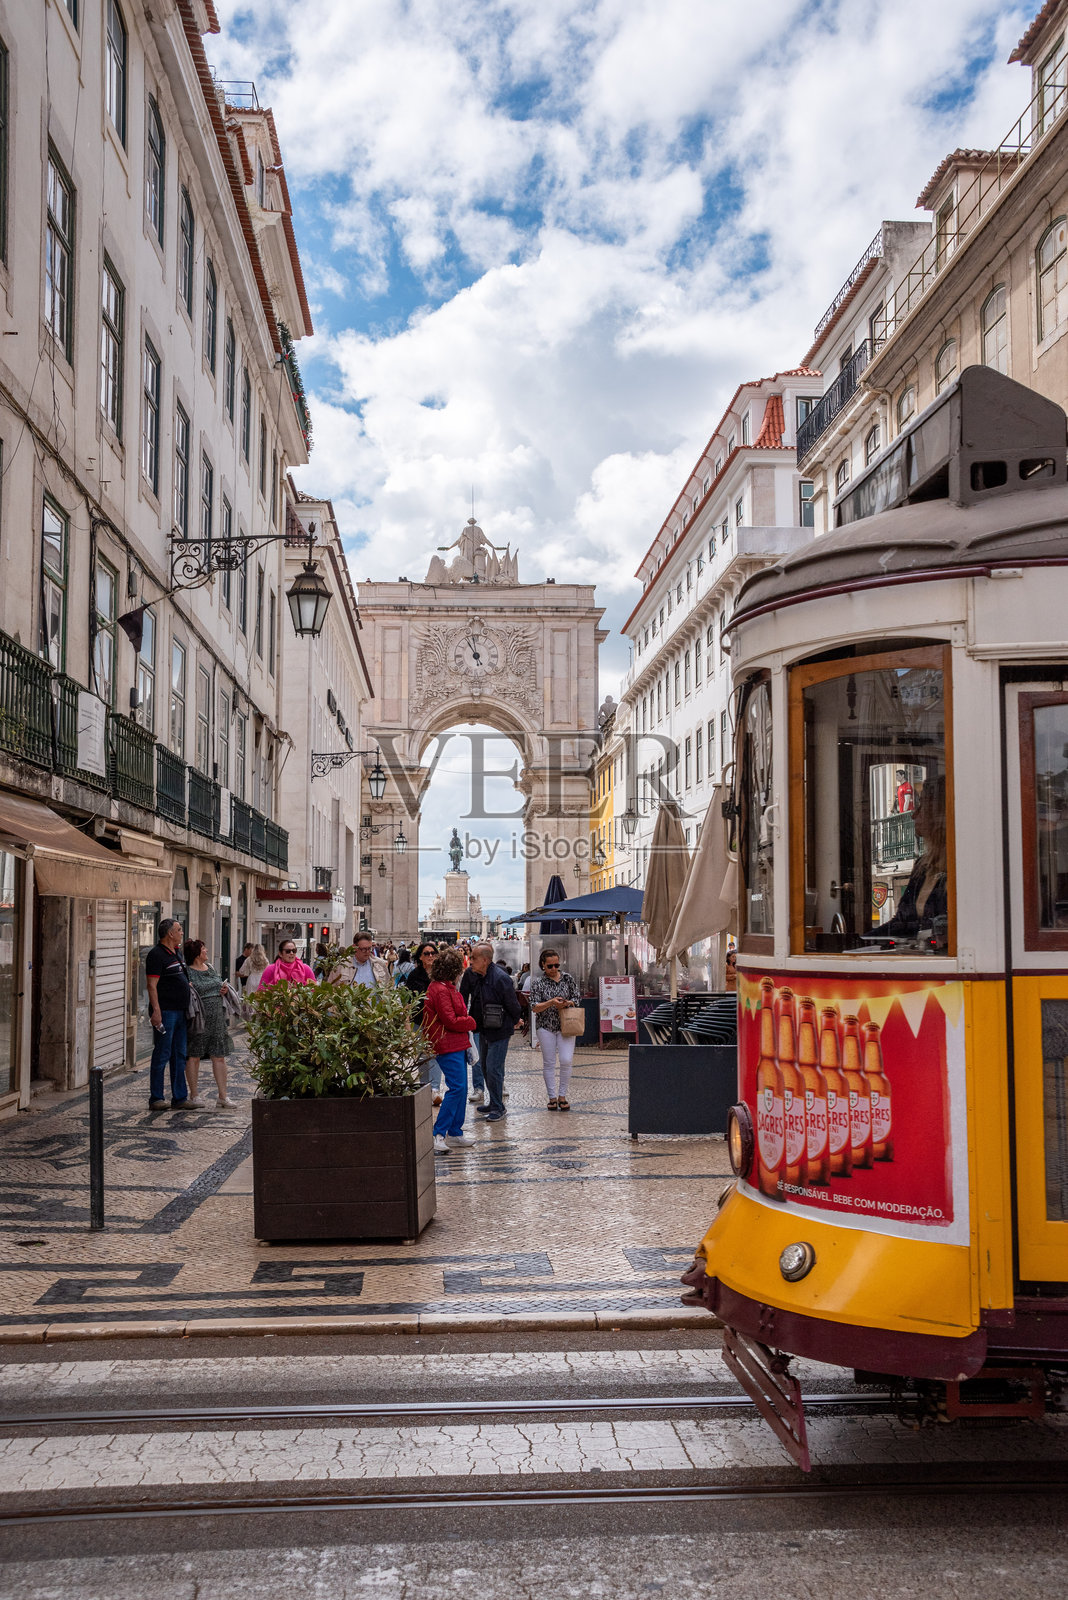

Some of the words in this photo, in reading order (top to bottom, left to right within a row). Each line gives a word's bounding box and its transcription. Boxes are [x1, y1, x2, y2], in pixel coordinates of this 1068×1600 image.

[268, 904, 320, 914] Restaurante
[833, 1193, 853, 1206] BEBE
[854, 1197, 876, 1209] COM
[877, 1201, 945, 1219] MODERAÇÃO.
